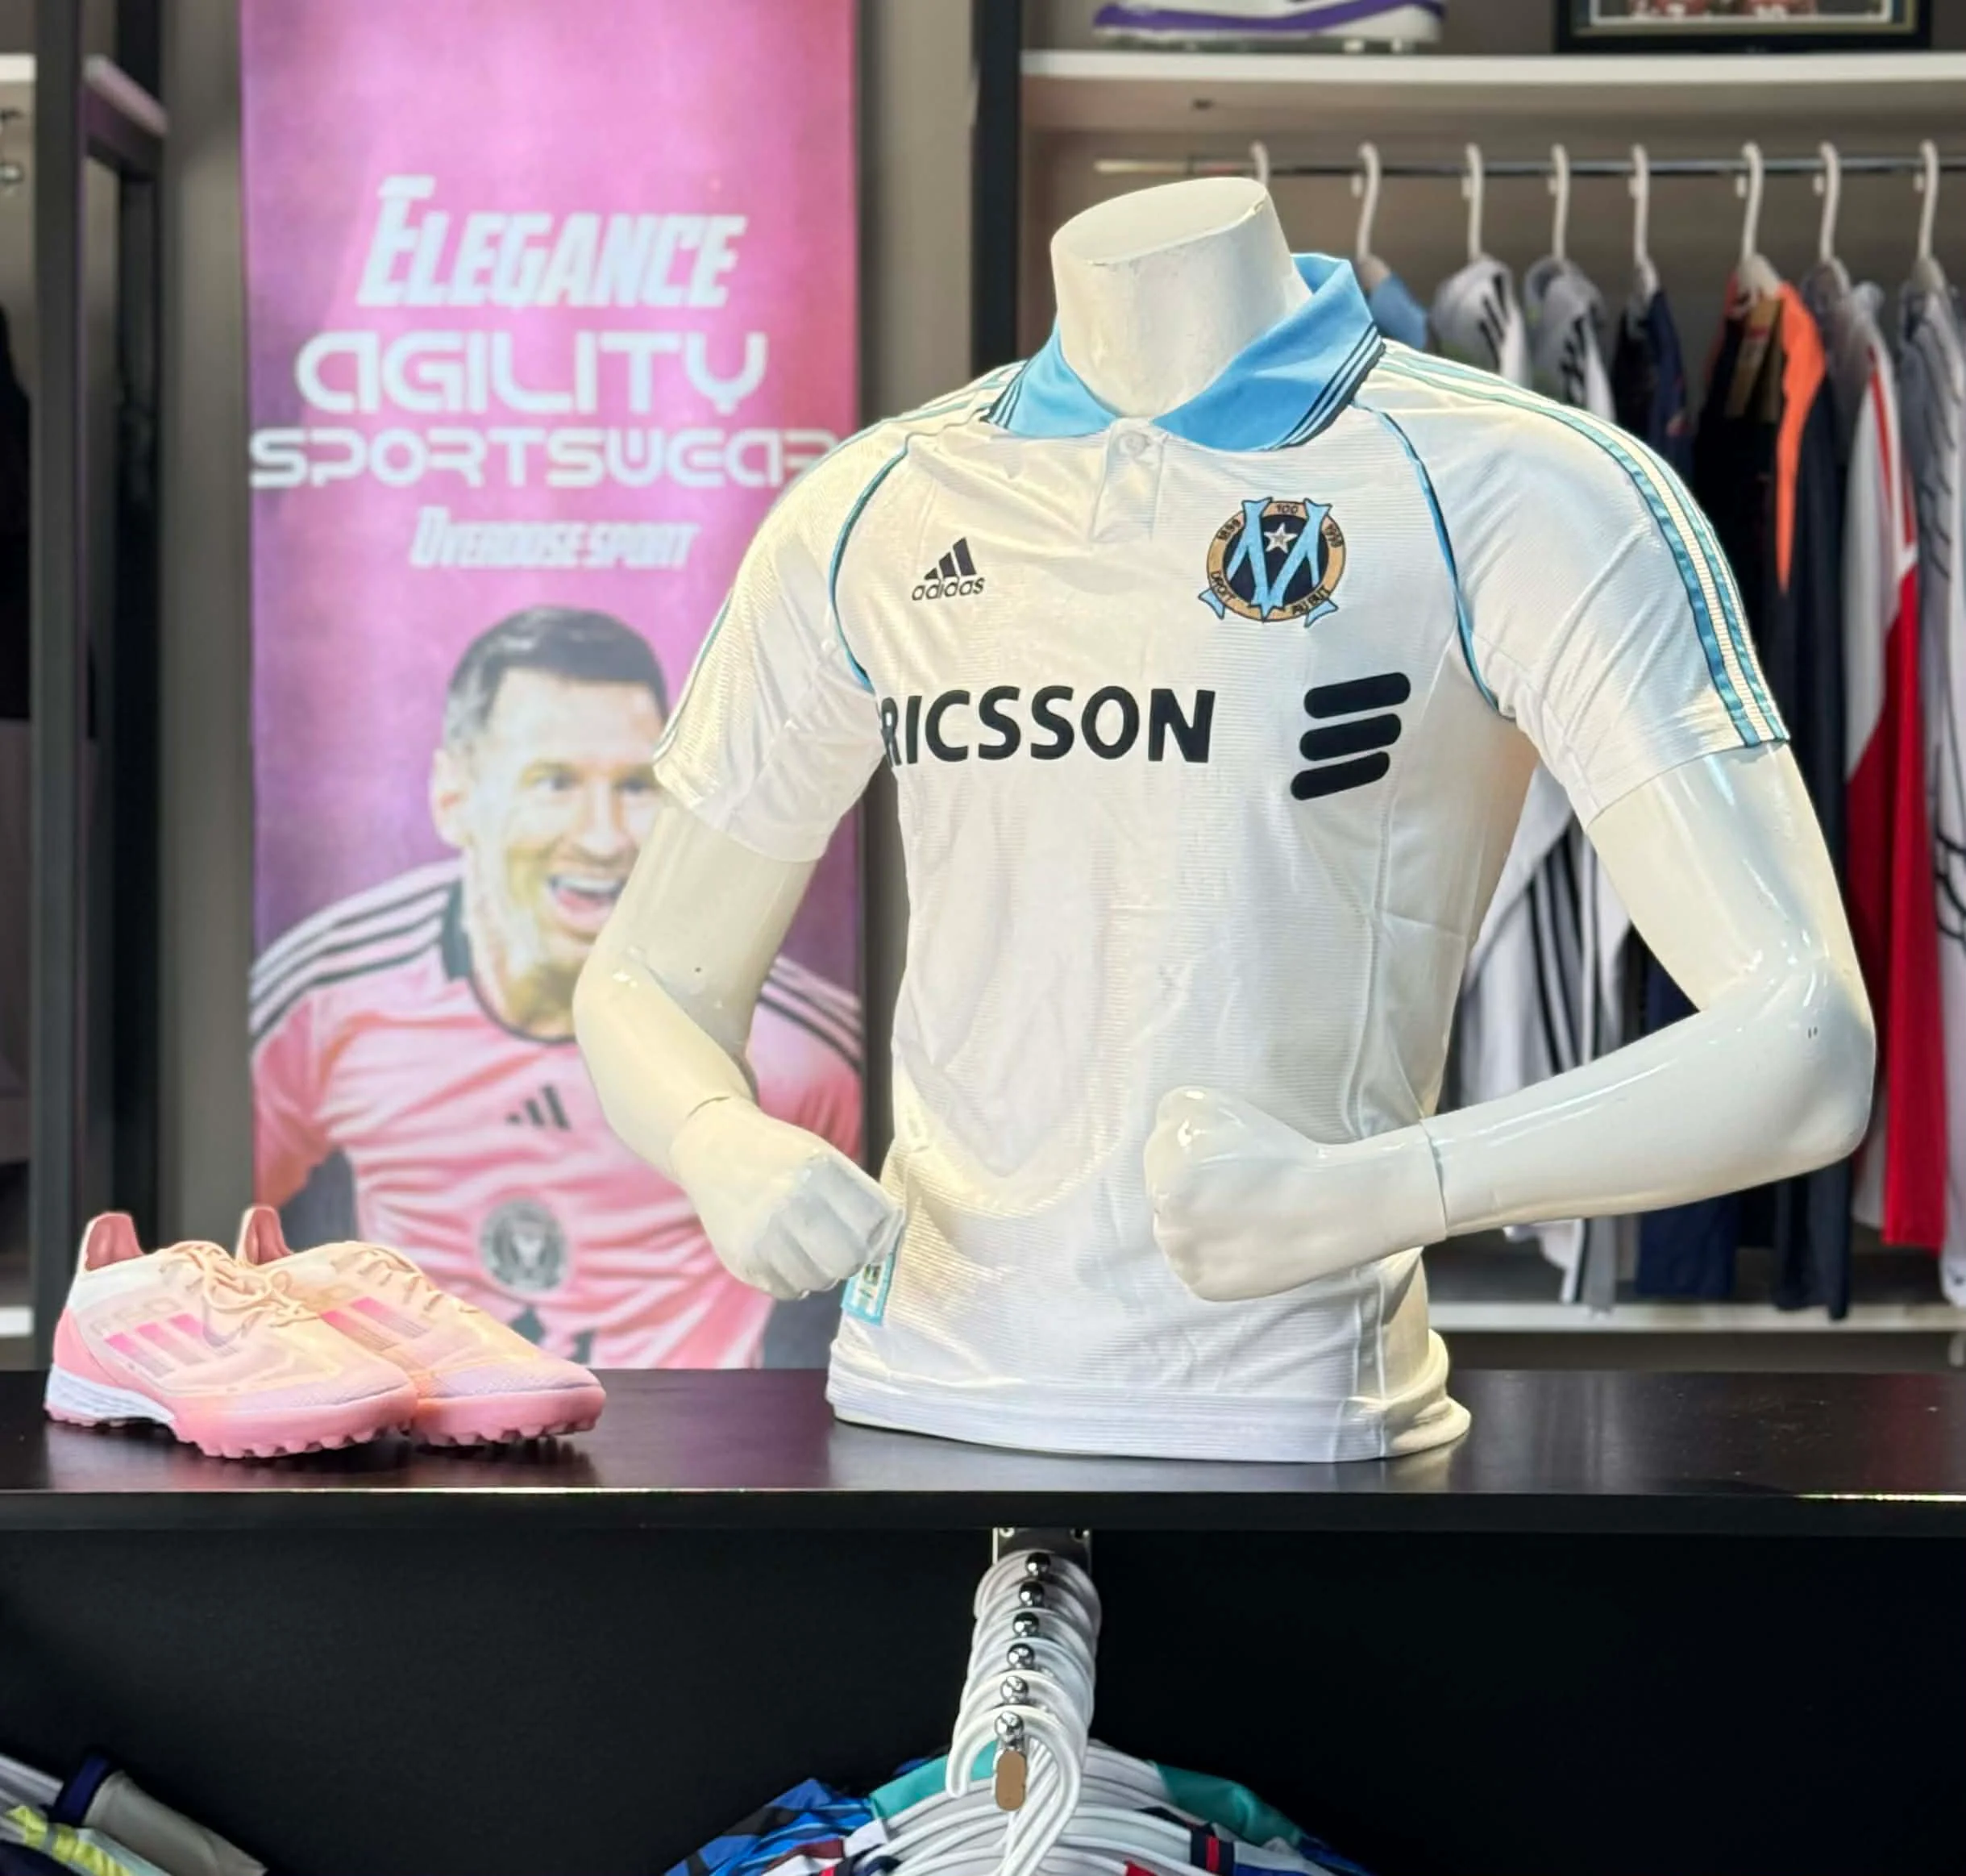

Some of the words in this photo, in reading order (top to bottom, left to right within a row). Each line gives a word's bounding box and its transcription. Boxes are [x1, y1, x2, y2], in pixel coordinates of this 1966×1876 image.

[356, 175, 746, 308] ELEGANCE
[295, 331, 768, 414] AGILITY
[911, 575, 986, 601] adidas
